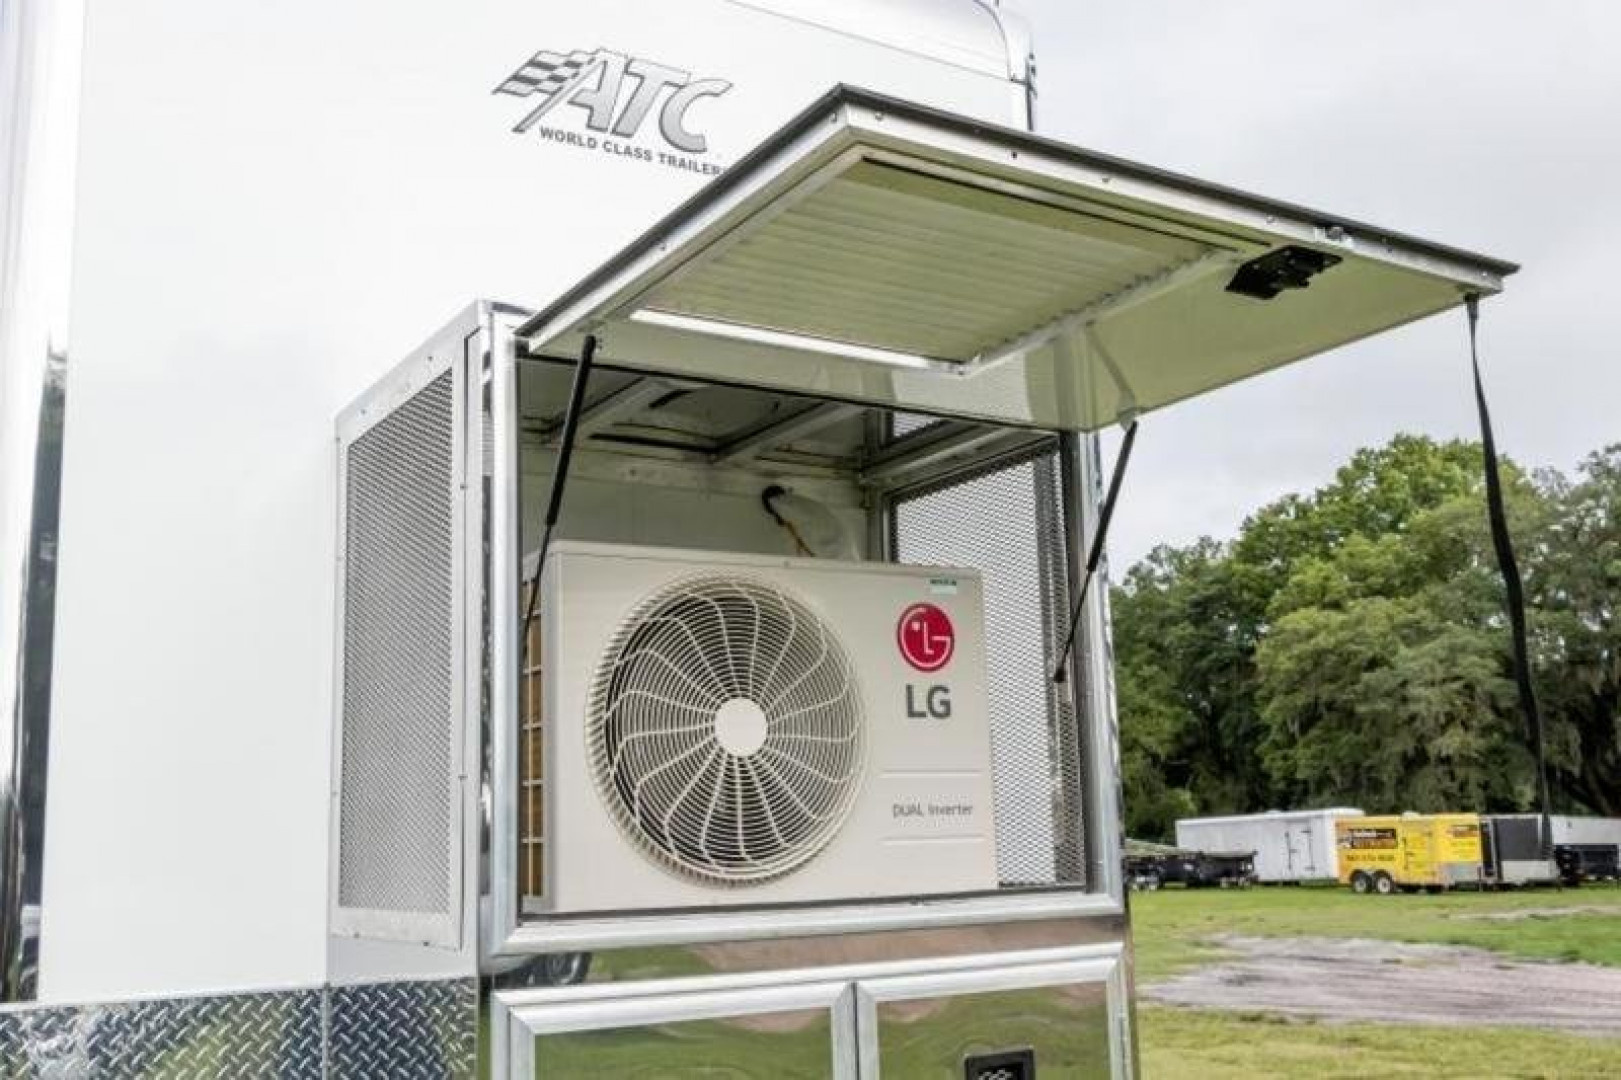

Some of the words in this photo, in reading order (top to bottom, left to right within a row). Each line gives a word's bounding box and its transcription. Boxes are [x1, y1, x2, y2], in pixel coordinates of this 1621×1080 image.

[513, 46, 734, 153] ATC
[539, 125, 598, 150] WORLD
[602, 140, 653, 163] CLASS
[657, 152, 725, 176] TRAILER
[905, 684, 951, 718] LG
[892, 802, 924, 818] DUAL
